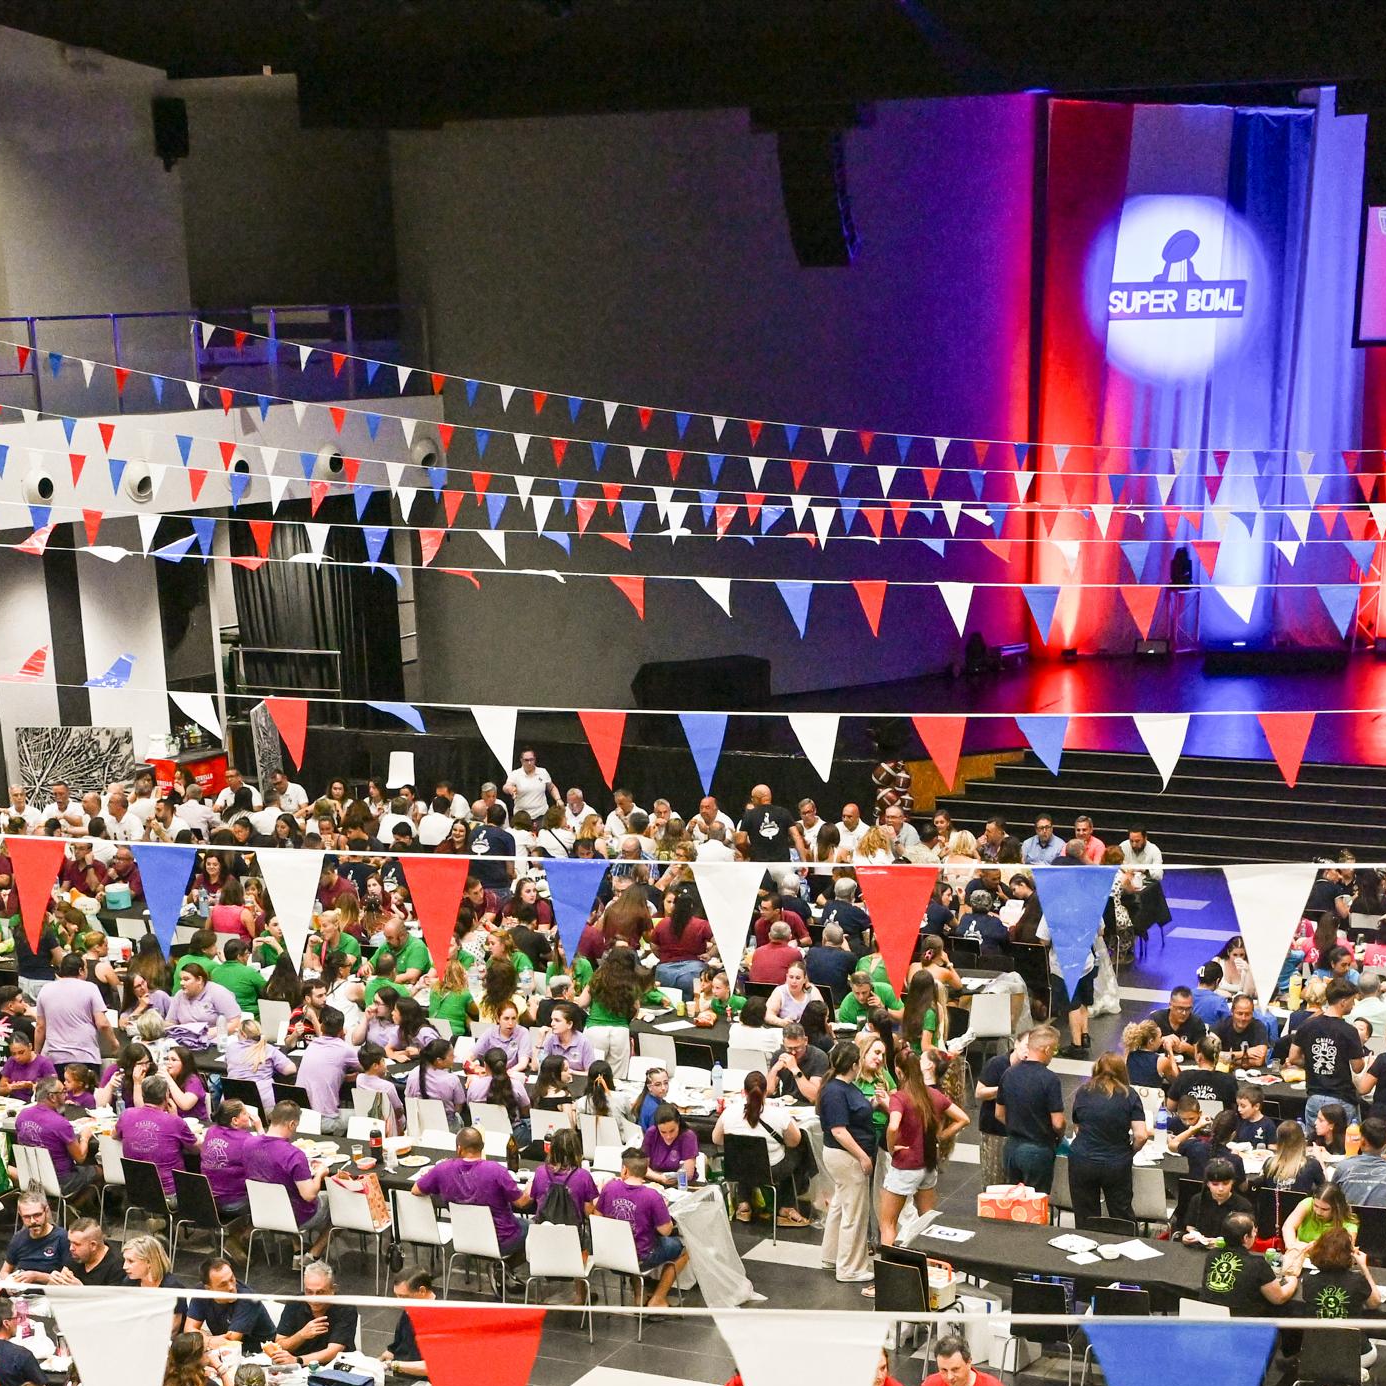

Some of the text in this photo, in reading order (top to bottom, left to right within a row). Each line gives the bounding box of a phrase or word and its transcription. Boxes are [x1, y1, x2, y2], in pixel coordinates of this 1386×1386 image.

[1108, 287, 1243, 314] SUPER BOWL
[1315, 1037, 1335, 1045] GAIATA
[1193, 1084, 1213, 1093] GAIATA
[1198, 1090, 1206, 1099] 12
[1219, 1263, 1228, 1272] 3
[1328, 1298, 1336, 1308] 3
